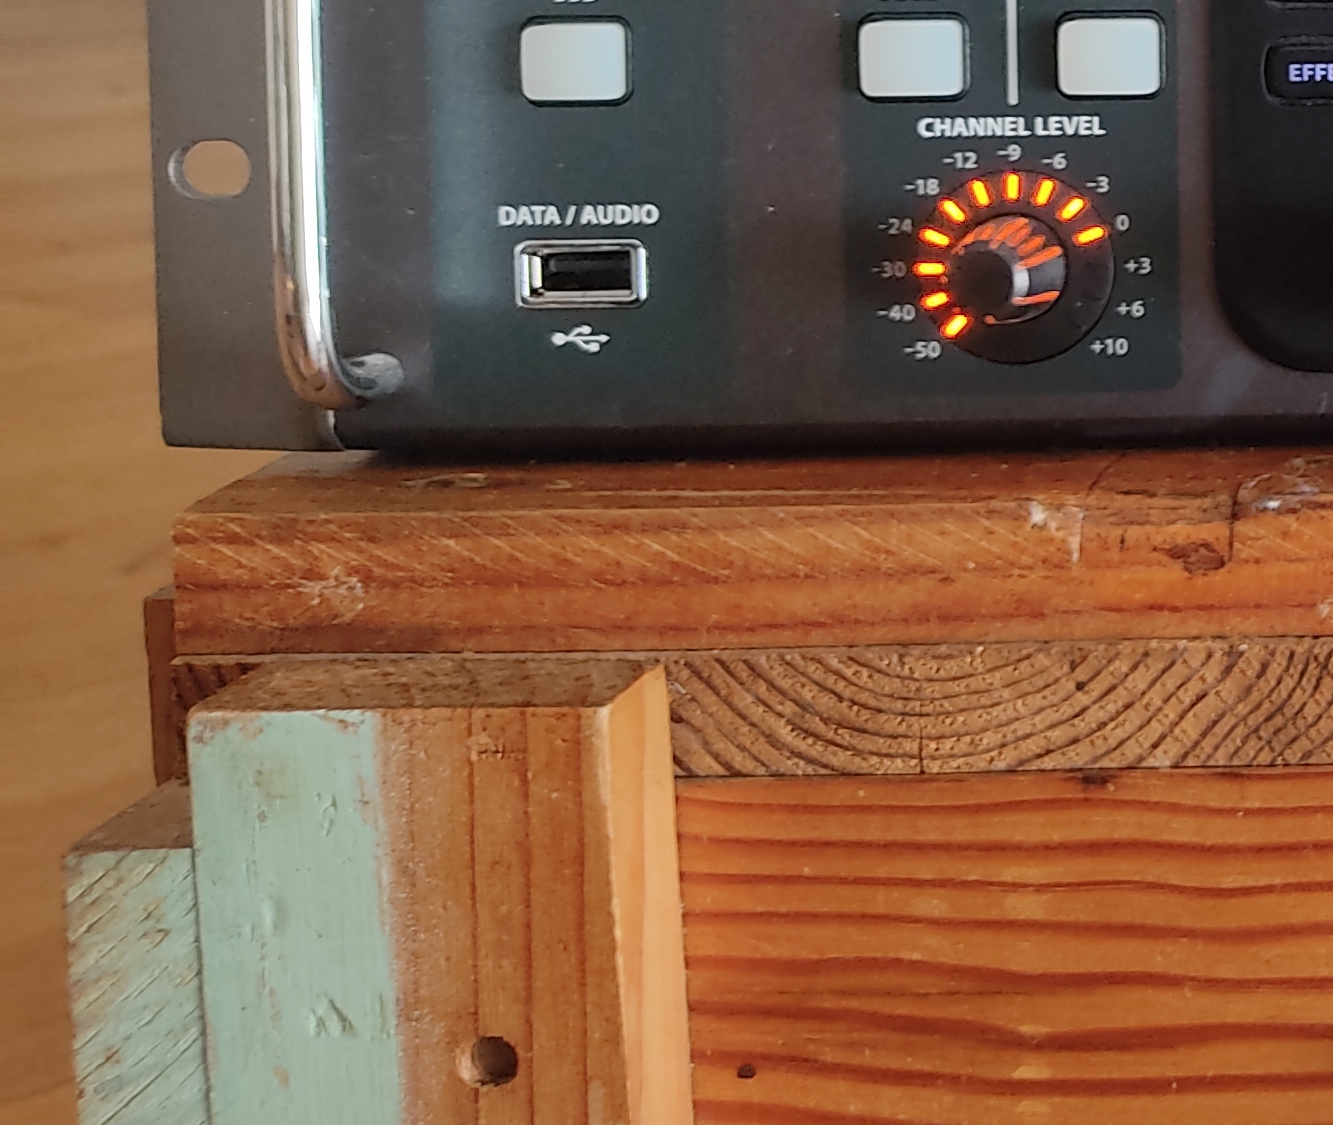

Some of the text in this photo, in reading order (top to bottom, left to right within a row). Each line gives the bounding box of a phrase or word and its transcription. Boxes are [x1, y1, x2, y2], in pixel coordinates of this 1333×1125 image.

[917, 116, 1107, 138] CHANNEL LEVEL
[943, 152, 979, 169] -12
[998, 144, 1022, 161] -9
[1042, 153, 1068, 170] -6
[905, 178, 941, 195] -18
[1086, 176, 1110, 193] -3
[498, 205, 561, 226] DATA
[580, 204, 660, 225] AUDIO
[1125, 258, 1152, 274] +3
[877, 304, 916, 321] -40
[1117, 301, 1145, 317] +6
[904, 342, 942, 359] -50
[1089, 338, 1129, 355] +10
